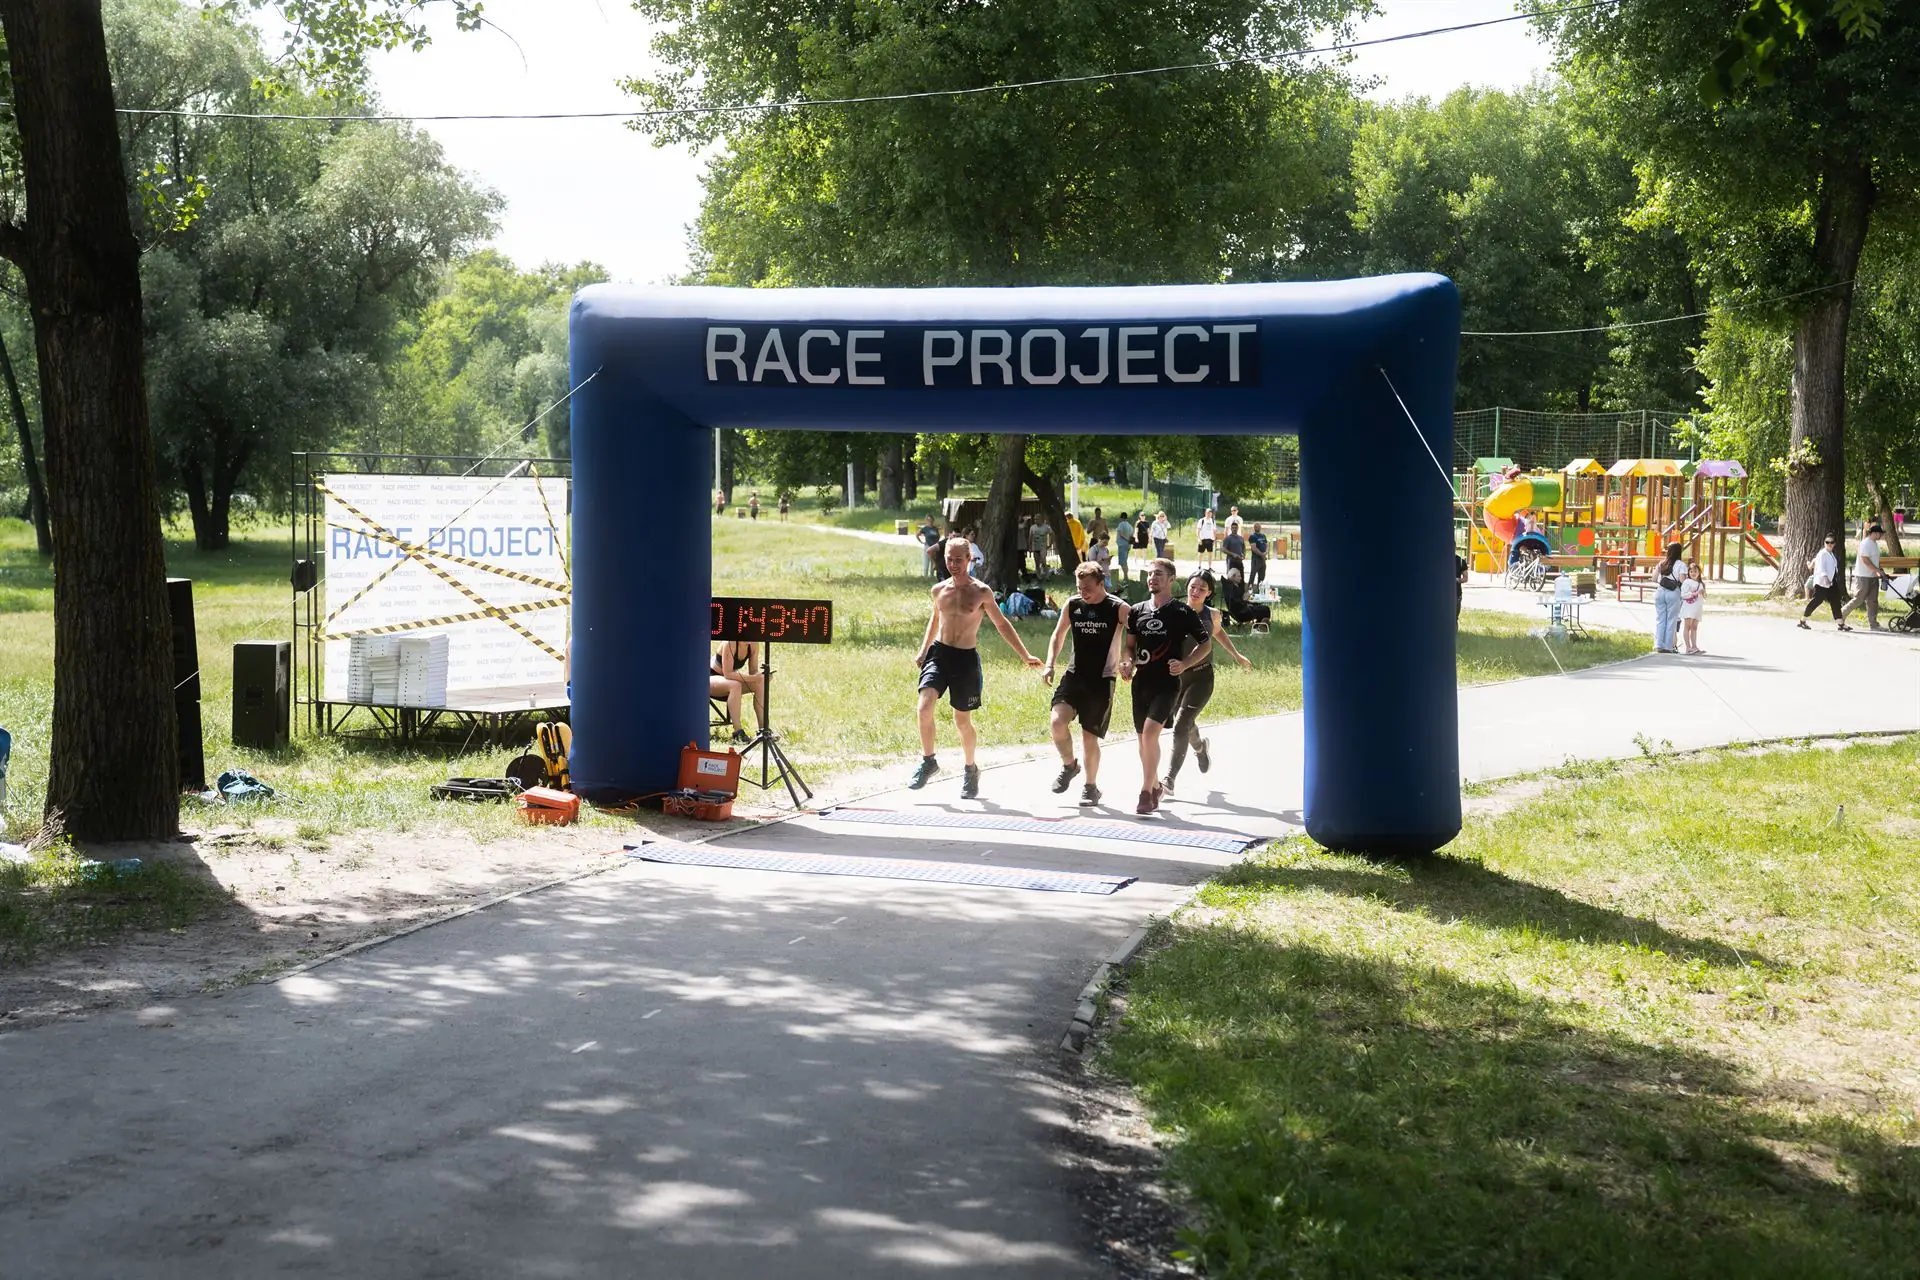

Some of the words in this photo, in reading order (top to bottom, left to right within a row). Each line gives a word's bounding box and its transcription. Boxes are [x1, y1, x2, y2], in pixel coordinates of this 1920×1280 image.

[705, 326, 886, 385] RACE
[922, 323, 1258, 386] PROJECT
[332, 527, 412, 560] RACE
[428, 526, 559, 559] PROJECT
